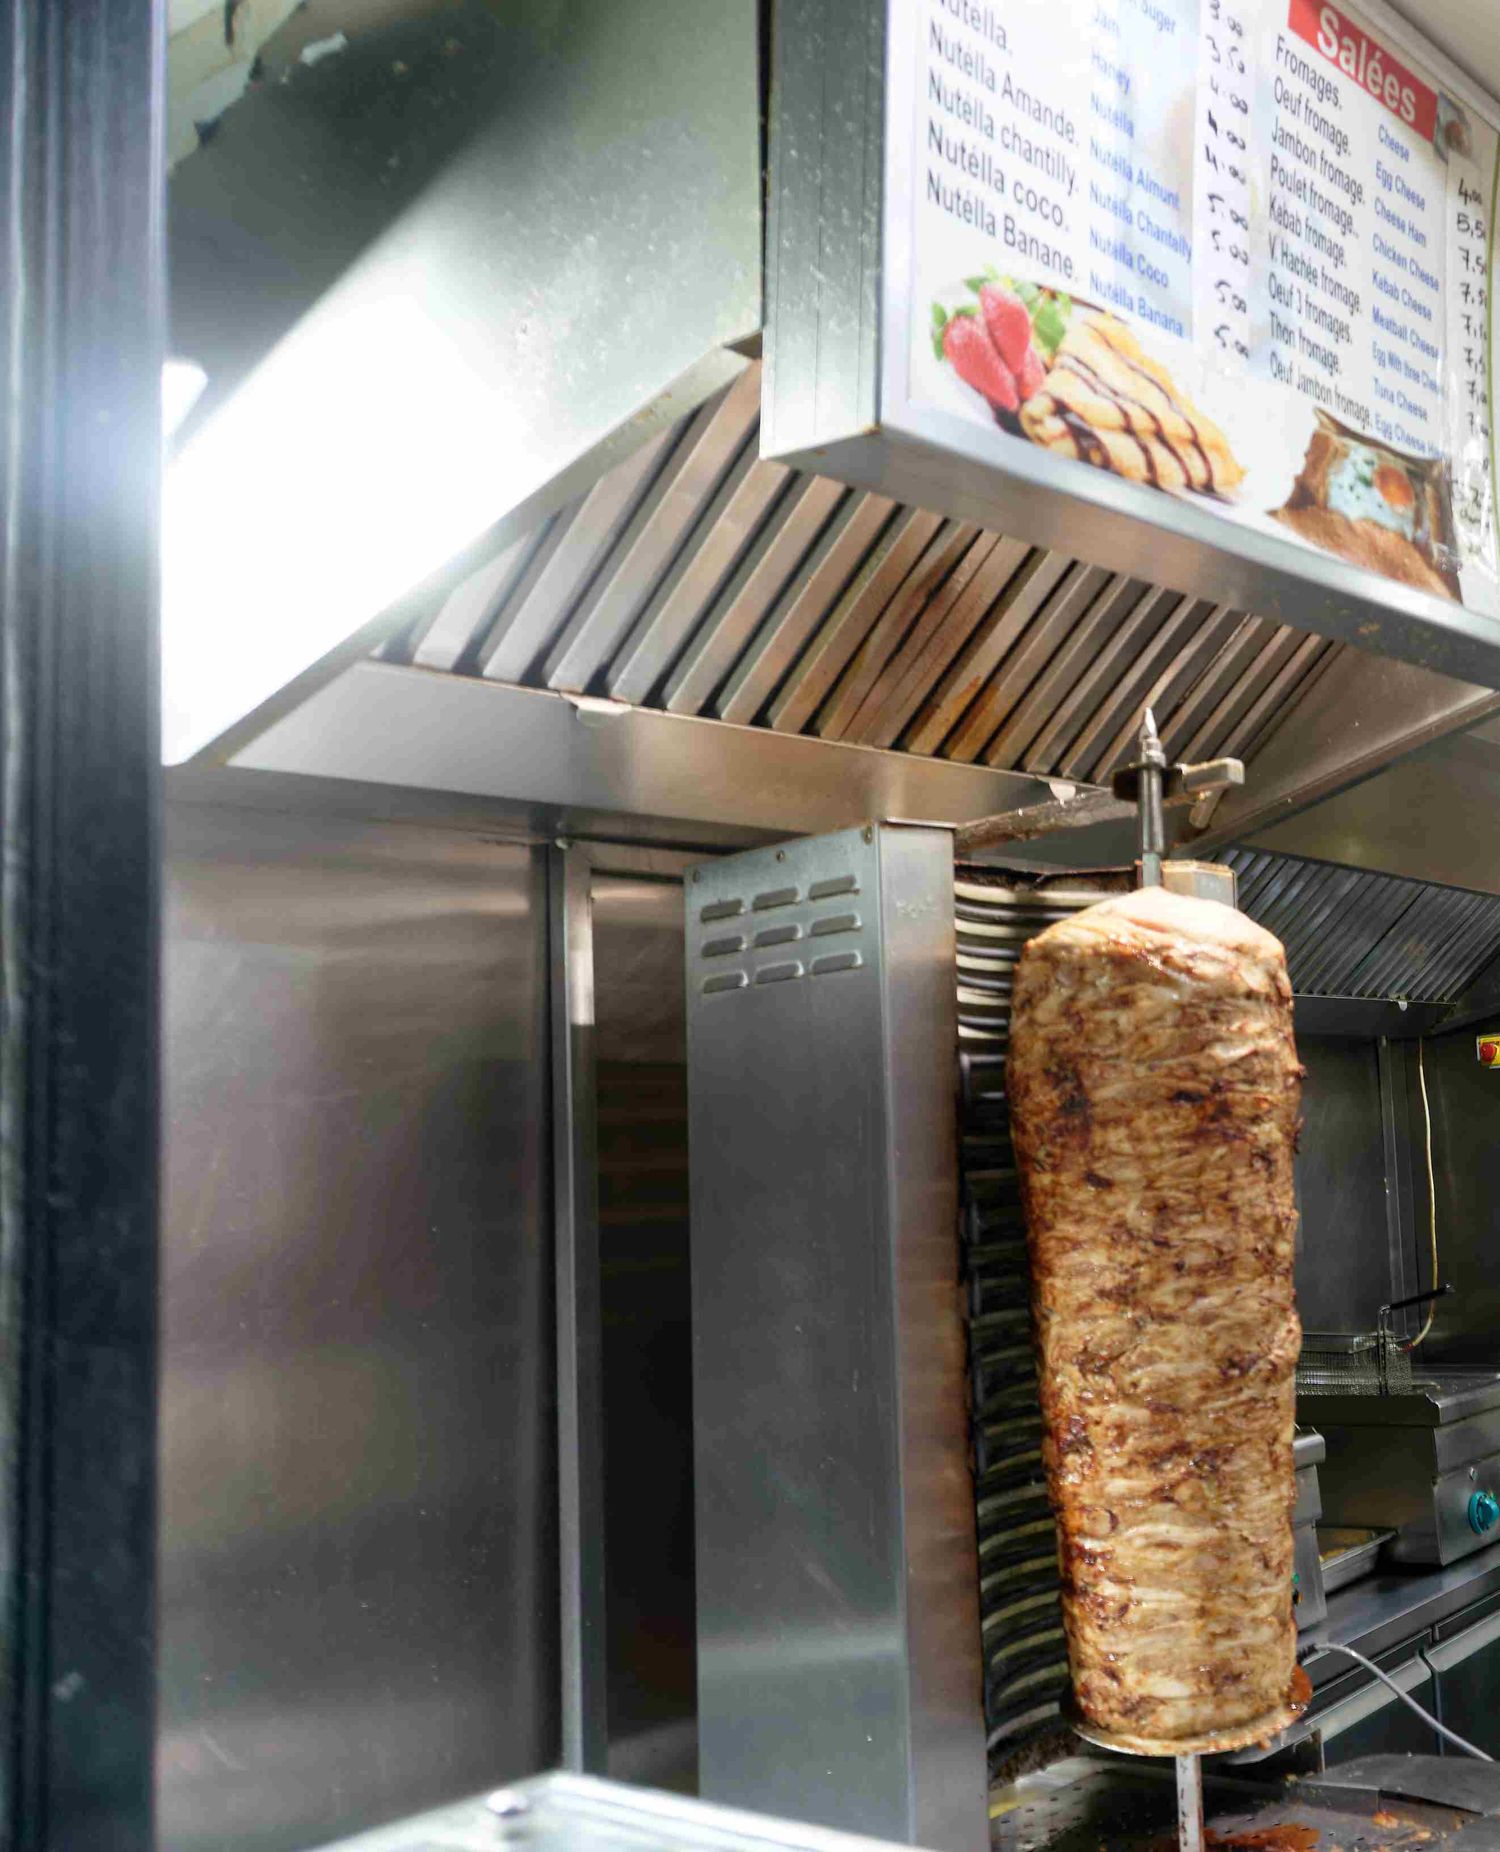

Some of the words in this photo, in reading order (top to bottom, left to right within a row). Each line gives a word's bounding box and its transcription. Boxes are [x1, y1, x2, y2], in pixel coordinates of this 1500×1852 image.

[1276, 35, 1342, 110] Fromages.
[1316, 8, 1416, 123] Salées
[1271, 116, 1317, 171] Jambon
[1377, 124, 1410, 163] Cheese
[1271, 153, 1307, 199] Poulet
[1375, 160, 1394, 195] Egg
[1013, 179, 1070, 232] coco.
[1003, 214, 1079, 283] Banane.
